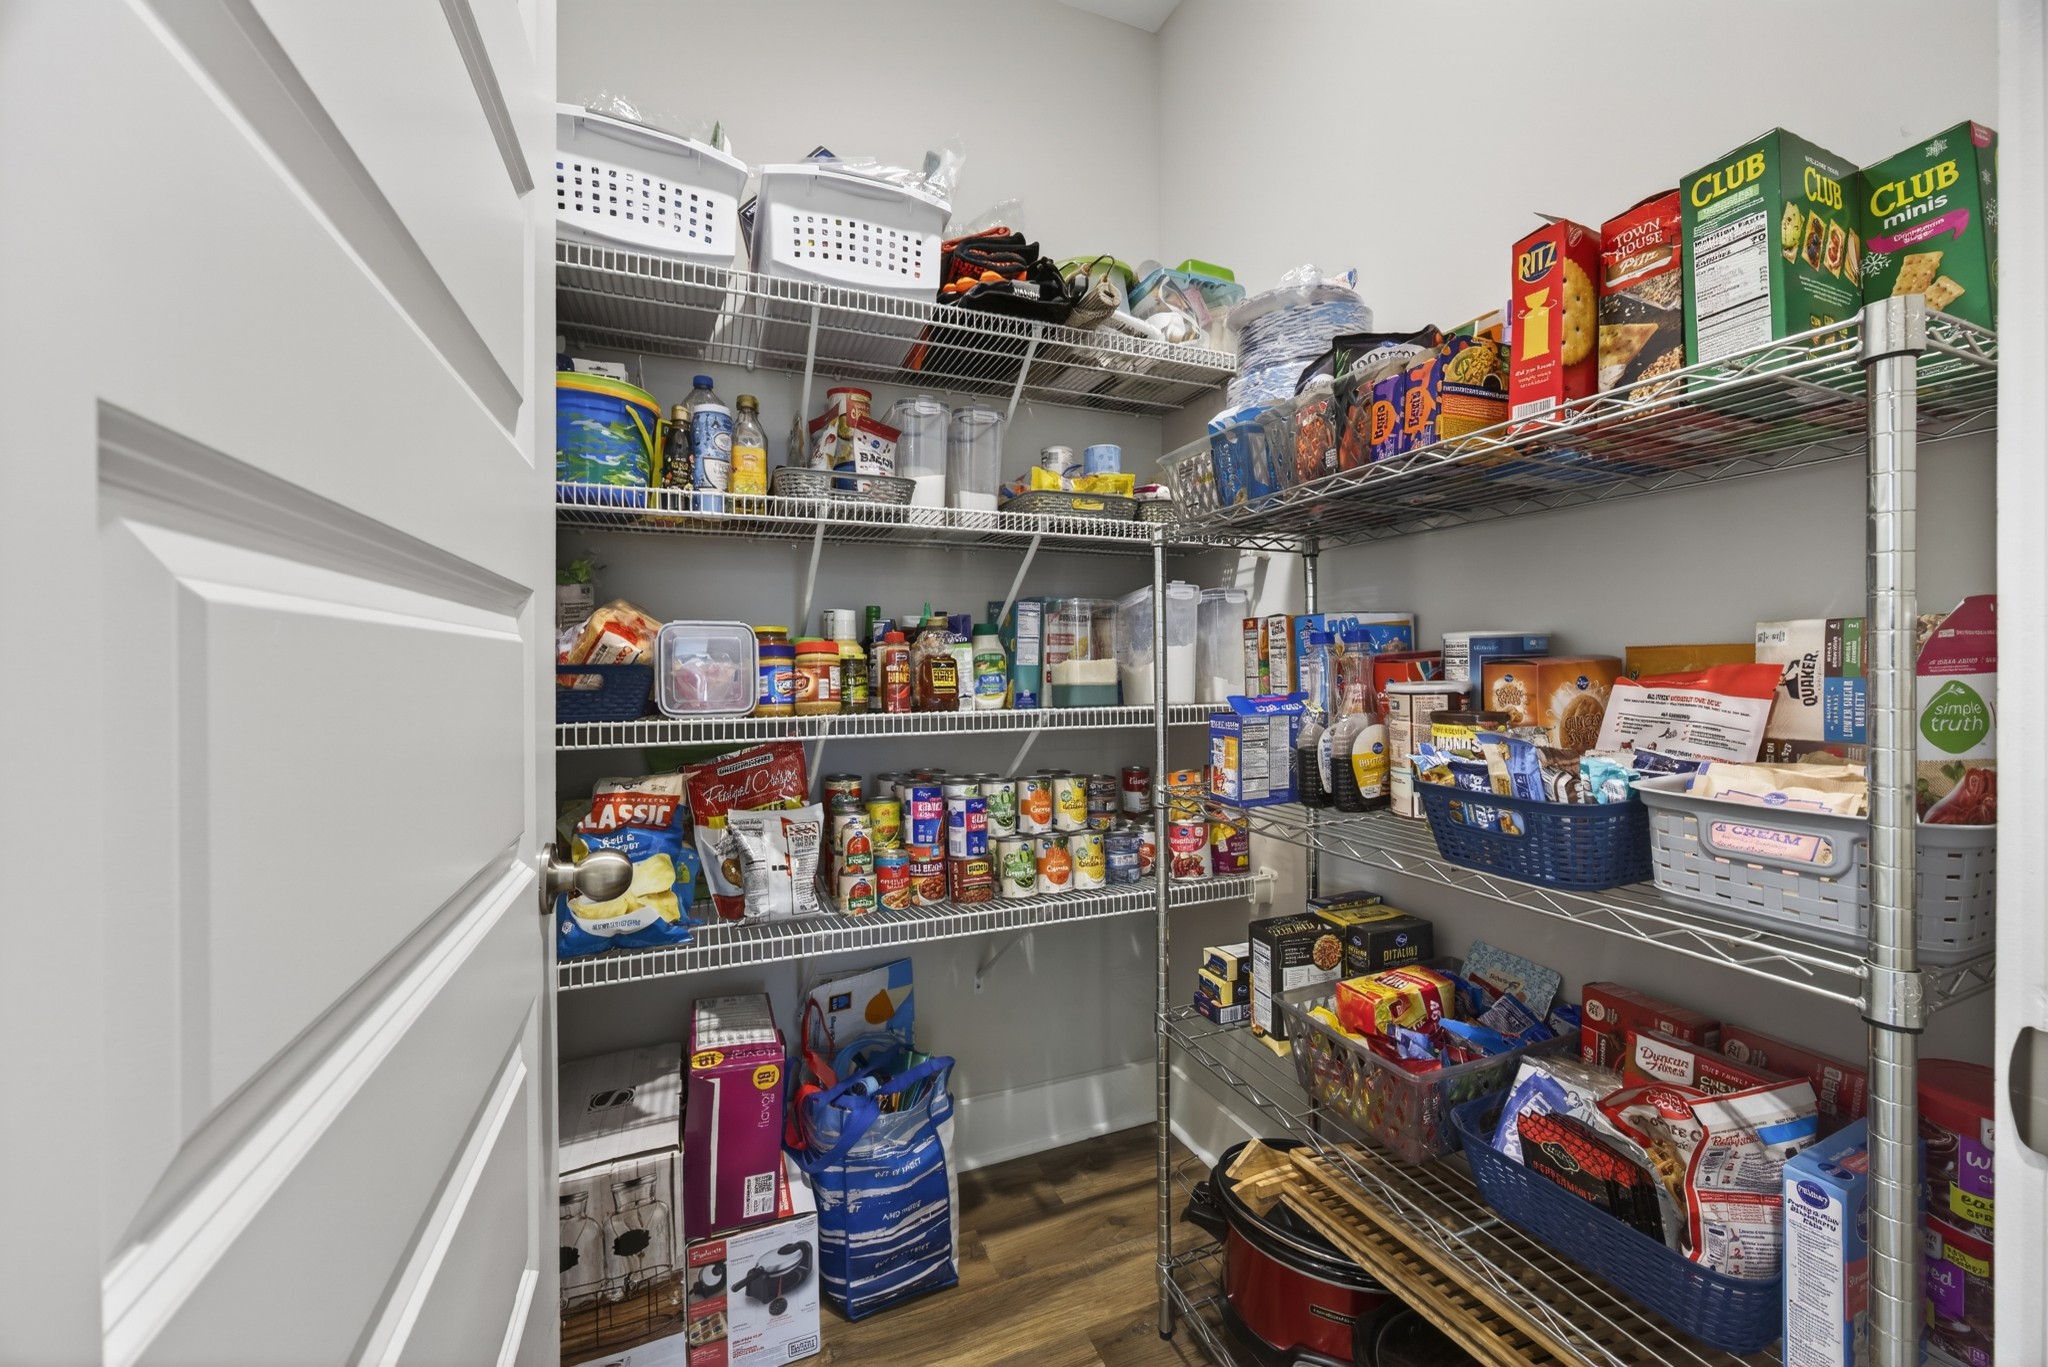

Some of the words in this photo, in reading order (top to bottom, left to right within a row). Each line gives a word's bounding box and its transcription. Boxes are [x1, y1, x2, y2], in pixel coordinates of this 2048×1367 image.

[1691, 150, 1766, 207] CLUB
[1804, 166, 1842, 210] CLUB
[1870, 160, 1960, 217] CLUB
[1884, 194, 1948, 230] minis
[1613, 217, 1660, 248] TOWN
[1614, 230, 1662, 262] HOUSE
[1518, 241, 1557, 281] RITZ
[1800, 652, 1819, 707] QUAKER
[1931, 715, 1984, 733] truth
[1934, 700, 1982, 717] simple
[1731, 825, 1803, 847] CREAM
[1639, 1045, 1690, 1069] Duncan
